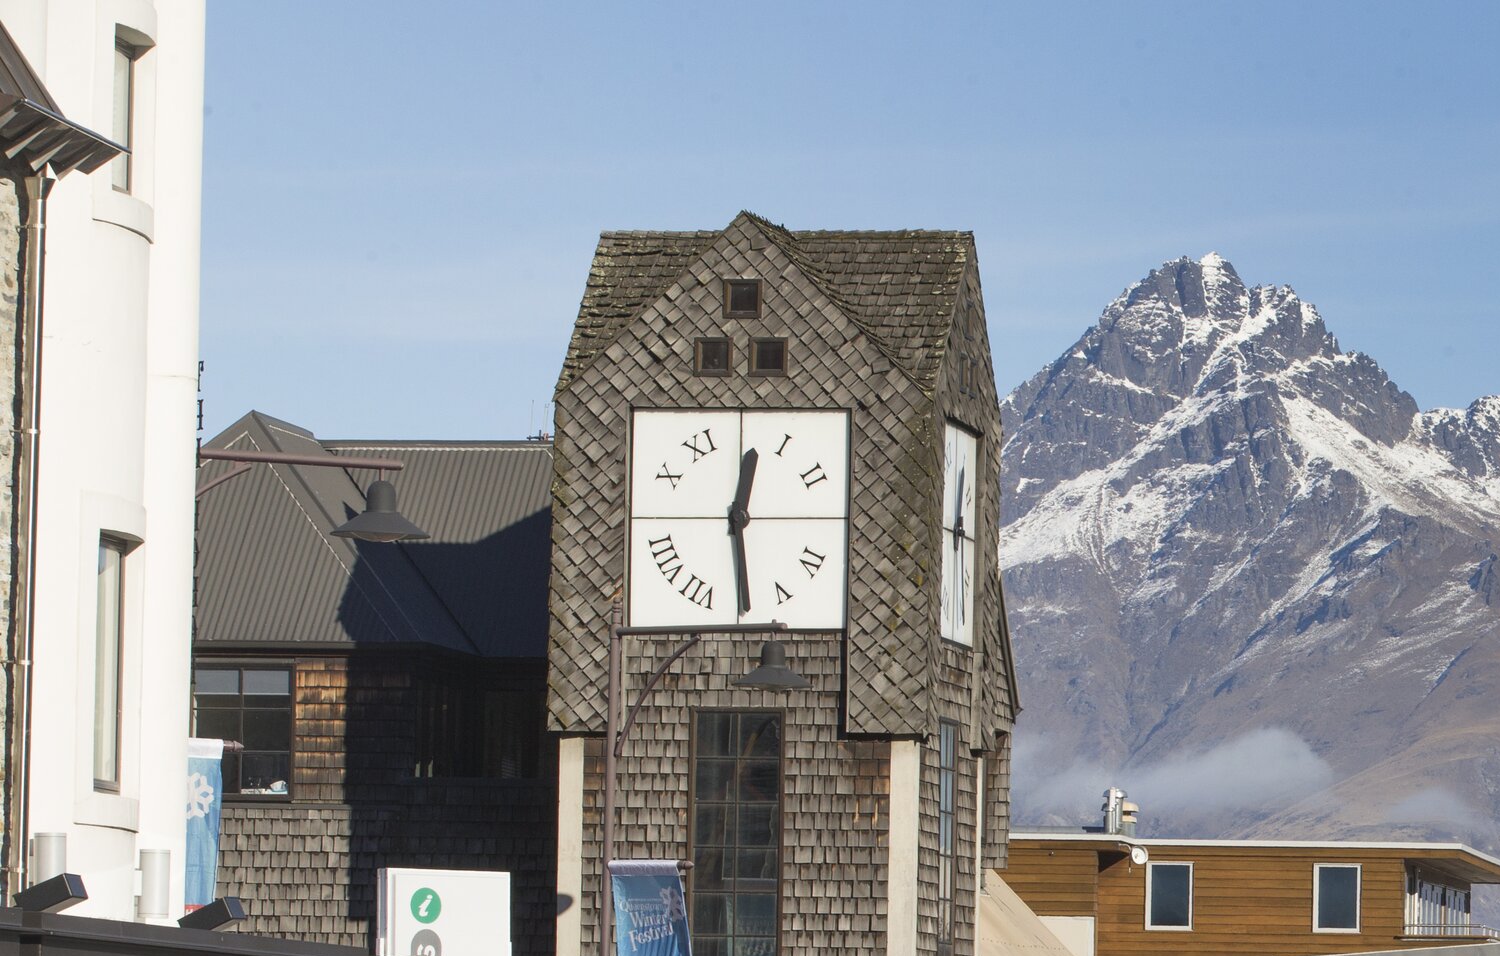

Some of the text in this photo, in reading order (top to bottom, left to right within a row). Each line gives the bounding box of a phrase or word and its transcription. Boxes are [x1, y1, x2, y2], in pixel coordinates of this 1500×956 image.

[681, 429, 718, 463] XI
[655, 462, 684, 490] X
[629, 912, 667, 928] Winter
[629, 921, 674, 952] Festival
